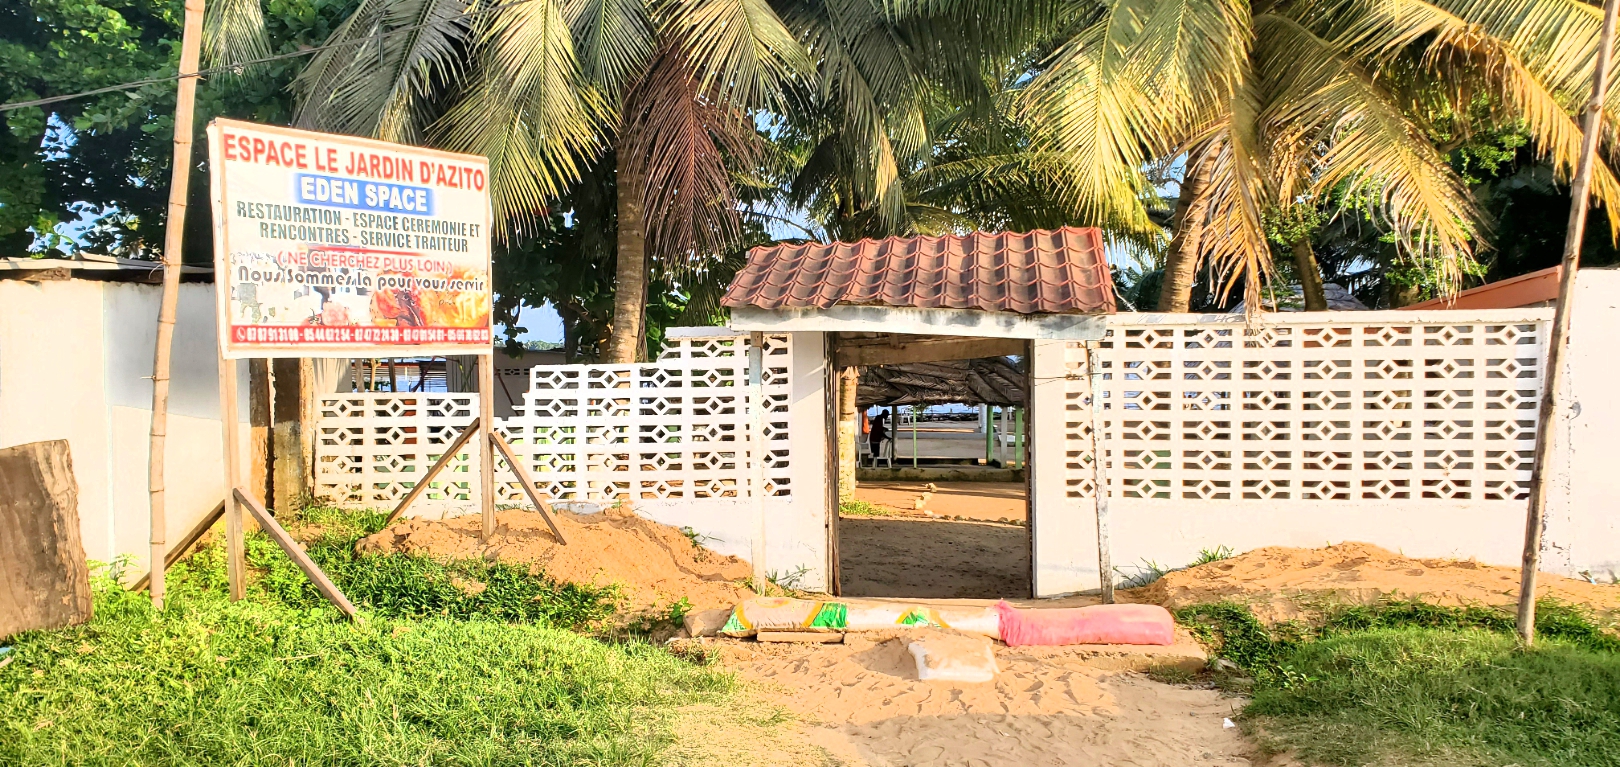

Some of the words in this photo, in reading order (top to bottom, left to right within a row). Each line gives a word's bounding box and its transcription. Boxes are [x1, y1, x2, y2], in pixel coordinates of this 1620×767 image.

[224, 134, 308, 169] ESPACE
[314, 148, 338, 172] LE
[345, 151, 413, 182] JARDIN
[420, 162, 484, 192] D'AZITO
[301, 176, 358, 206] EDEN
[365, 184, 428, 212] SPACE
[237, 201, 342, 226] RESTAURATION
[353, 212, 399, 232] ESPACE
[402, 216, 466, 237] CEREMONIE
[470, 223, 480, 238] ET
[260, 222, 350, 244] RENCONTRES
[360, 232, 411, 248] SERVICE
[414, 235, 468, 252] TRAITEUR
[311, 252, 380, 268] CHERCHEZ
[384, 257, 413, 270] PLUS
[238, 266, 281, 282] Nous
[287, 268, 352, 286] Sommes
[378, 276, 412, 290] pour
[416, 278, 446, 290] vous
[450, 278, 484, 290] servir
